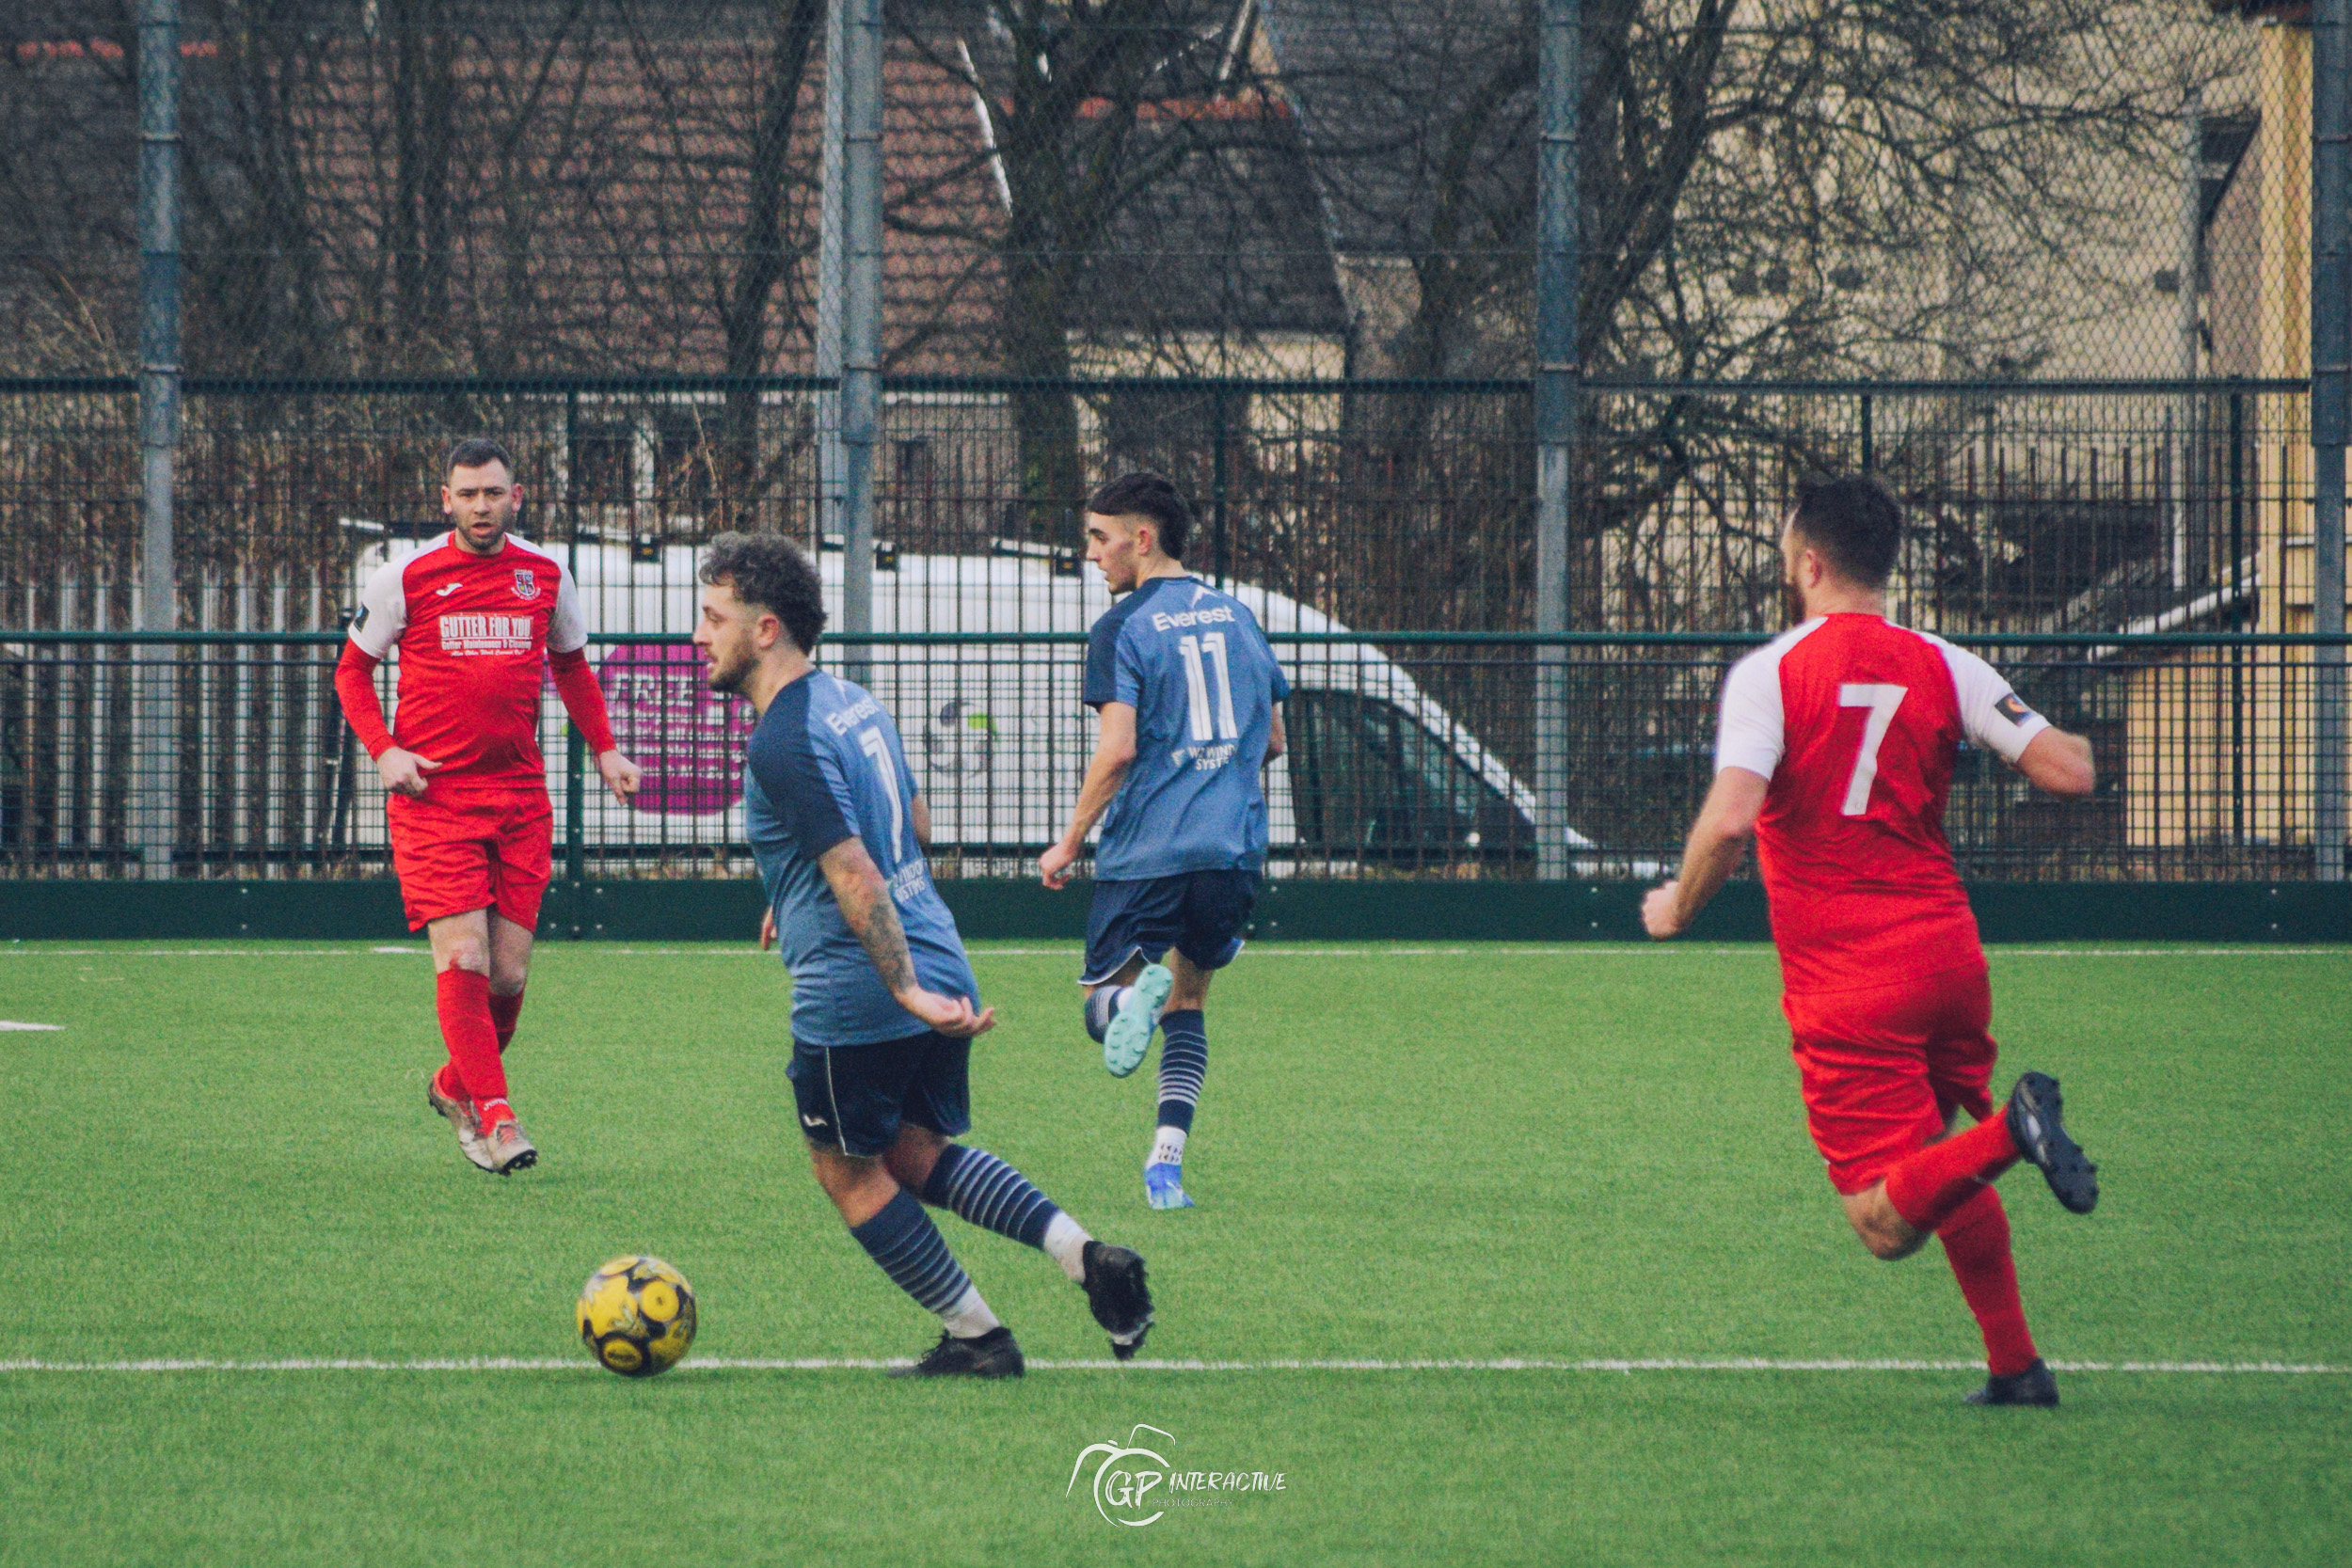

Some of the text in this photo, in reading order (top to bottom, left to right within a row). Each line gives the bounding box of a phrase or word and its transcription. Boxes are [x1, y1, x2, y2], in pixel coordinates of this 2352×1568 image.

[439, 616, 531, 638] GUTTER FOR YOU
[1152, 605, 1235, 632] Everest
[1179, 632, 1238, 741] 11
[1839, 684, 1909, 816] 7
